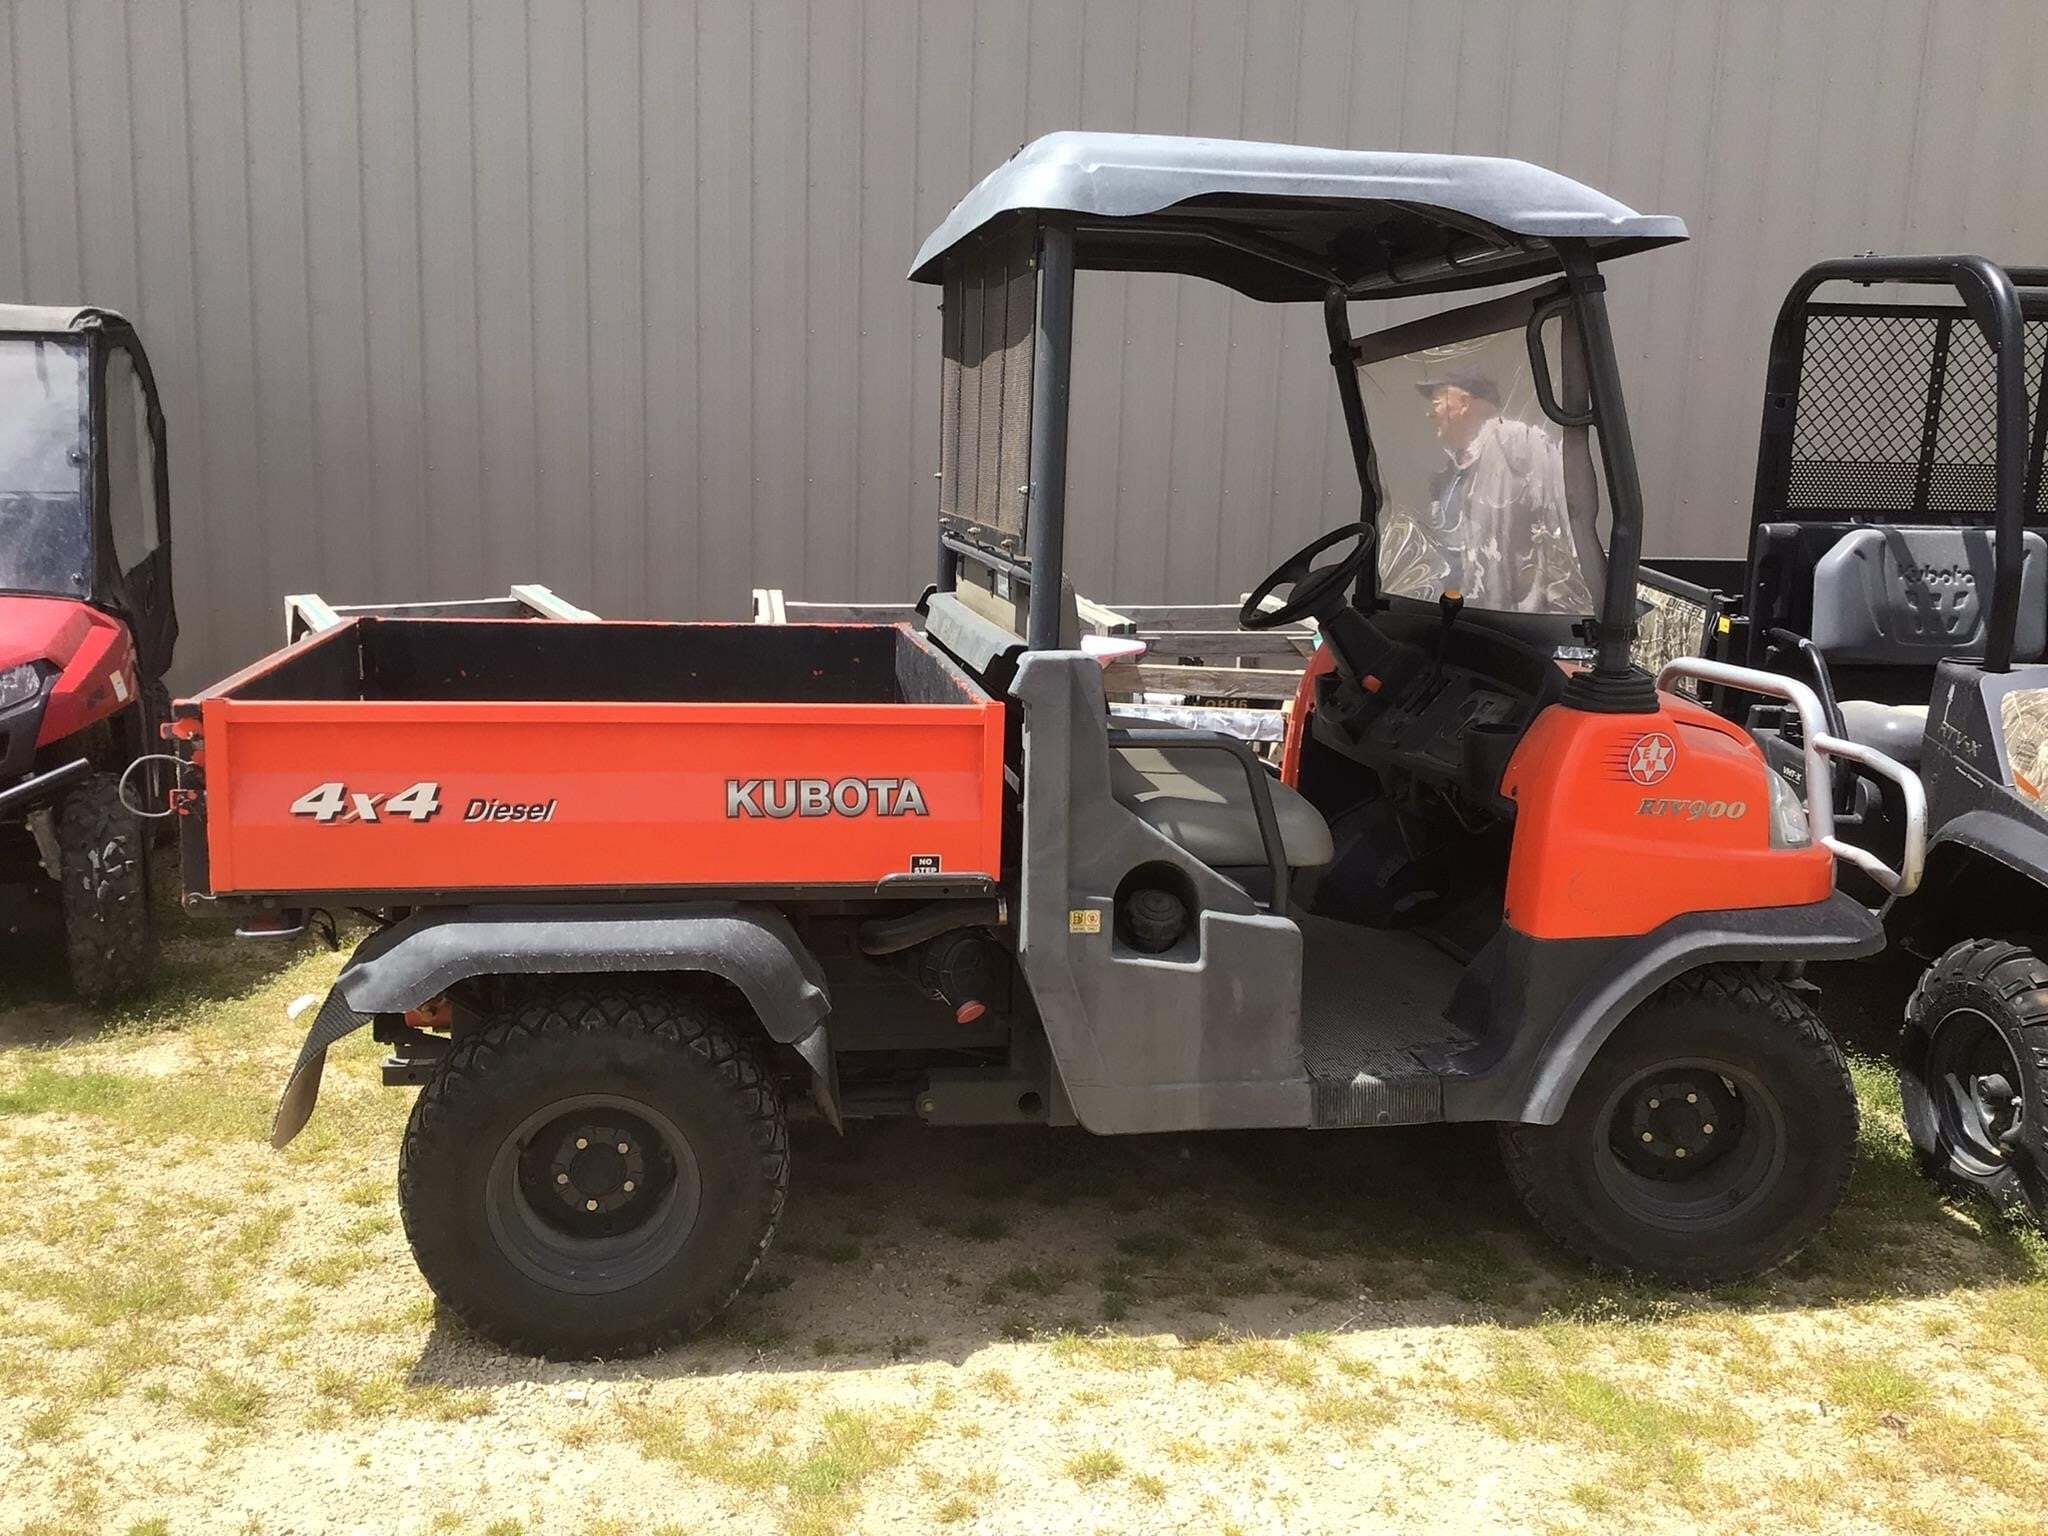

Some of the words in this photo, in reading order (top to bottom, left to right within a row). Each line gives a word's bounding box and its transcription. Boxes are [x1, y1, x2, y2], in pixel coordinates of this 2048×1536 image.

[289, 781, 443, 824] 4x4
[463, 797, 558, 824] Diesel
[725, 777, 929, 819] KUBOTA
[1634, 797, 1747, 821] RTV900
